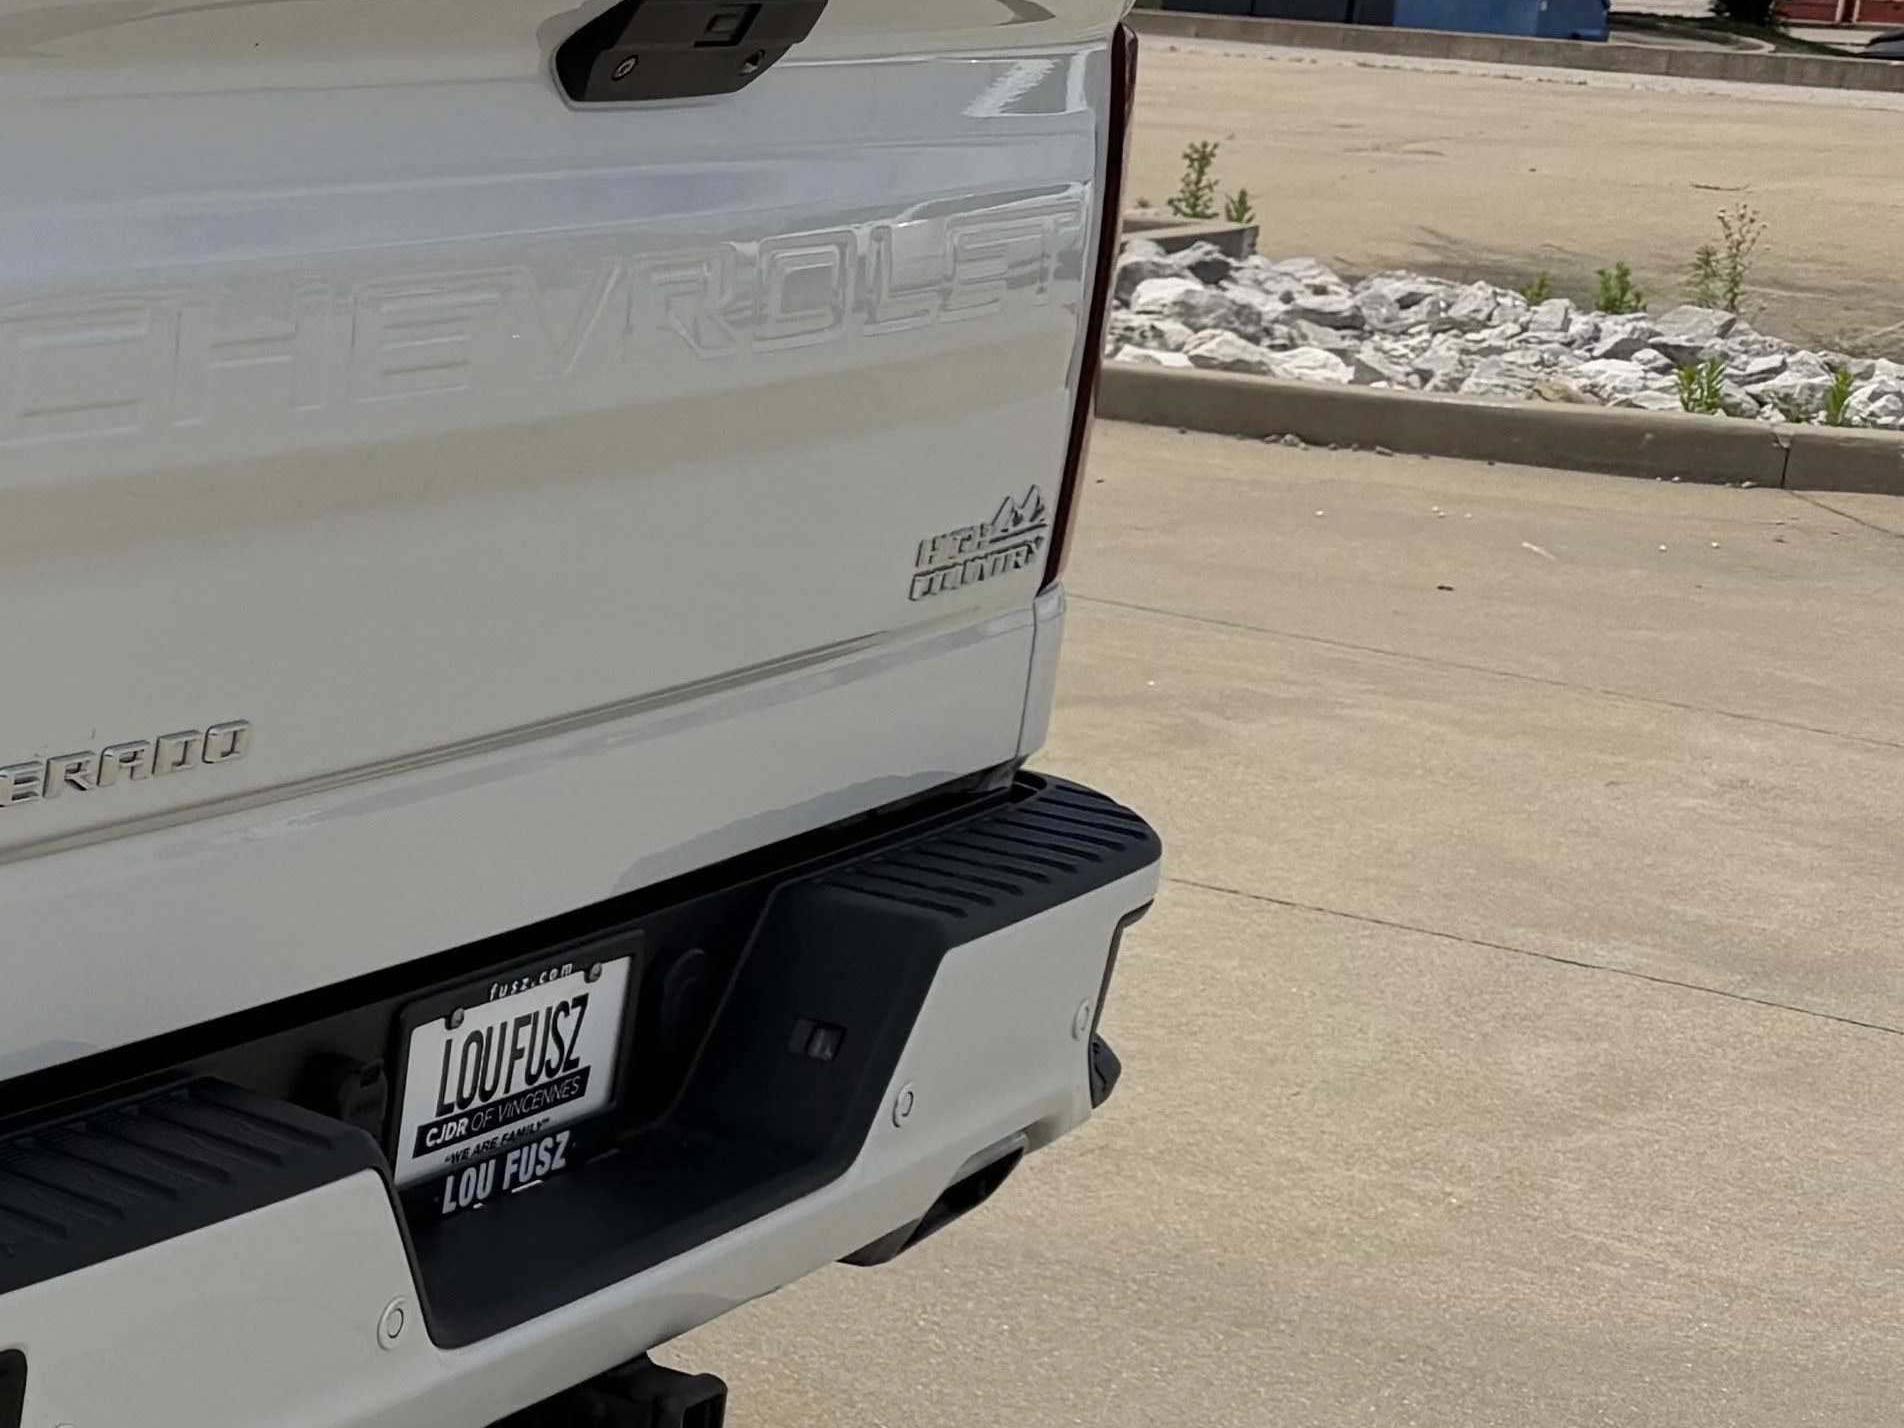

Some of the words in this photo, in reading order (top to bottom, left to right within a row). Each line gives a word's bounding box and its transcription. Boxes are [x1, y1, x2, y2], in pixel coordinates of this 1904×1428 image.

[489, 963, 573, 1002] fusz.com
[425, 1117, 470, 1148] CJDR
[470, 1107, 496, 1132] OF
[497, 1075, 581, 1123] VINCENNES
[442, 1158, 496, 1215] LOU
[502, 1129, 571, 1191] FUSZ
[472, 1136, 499, 1155] ARE
